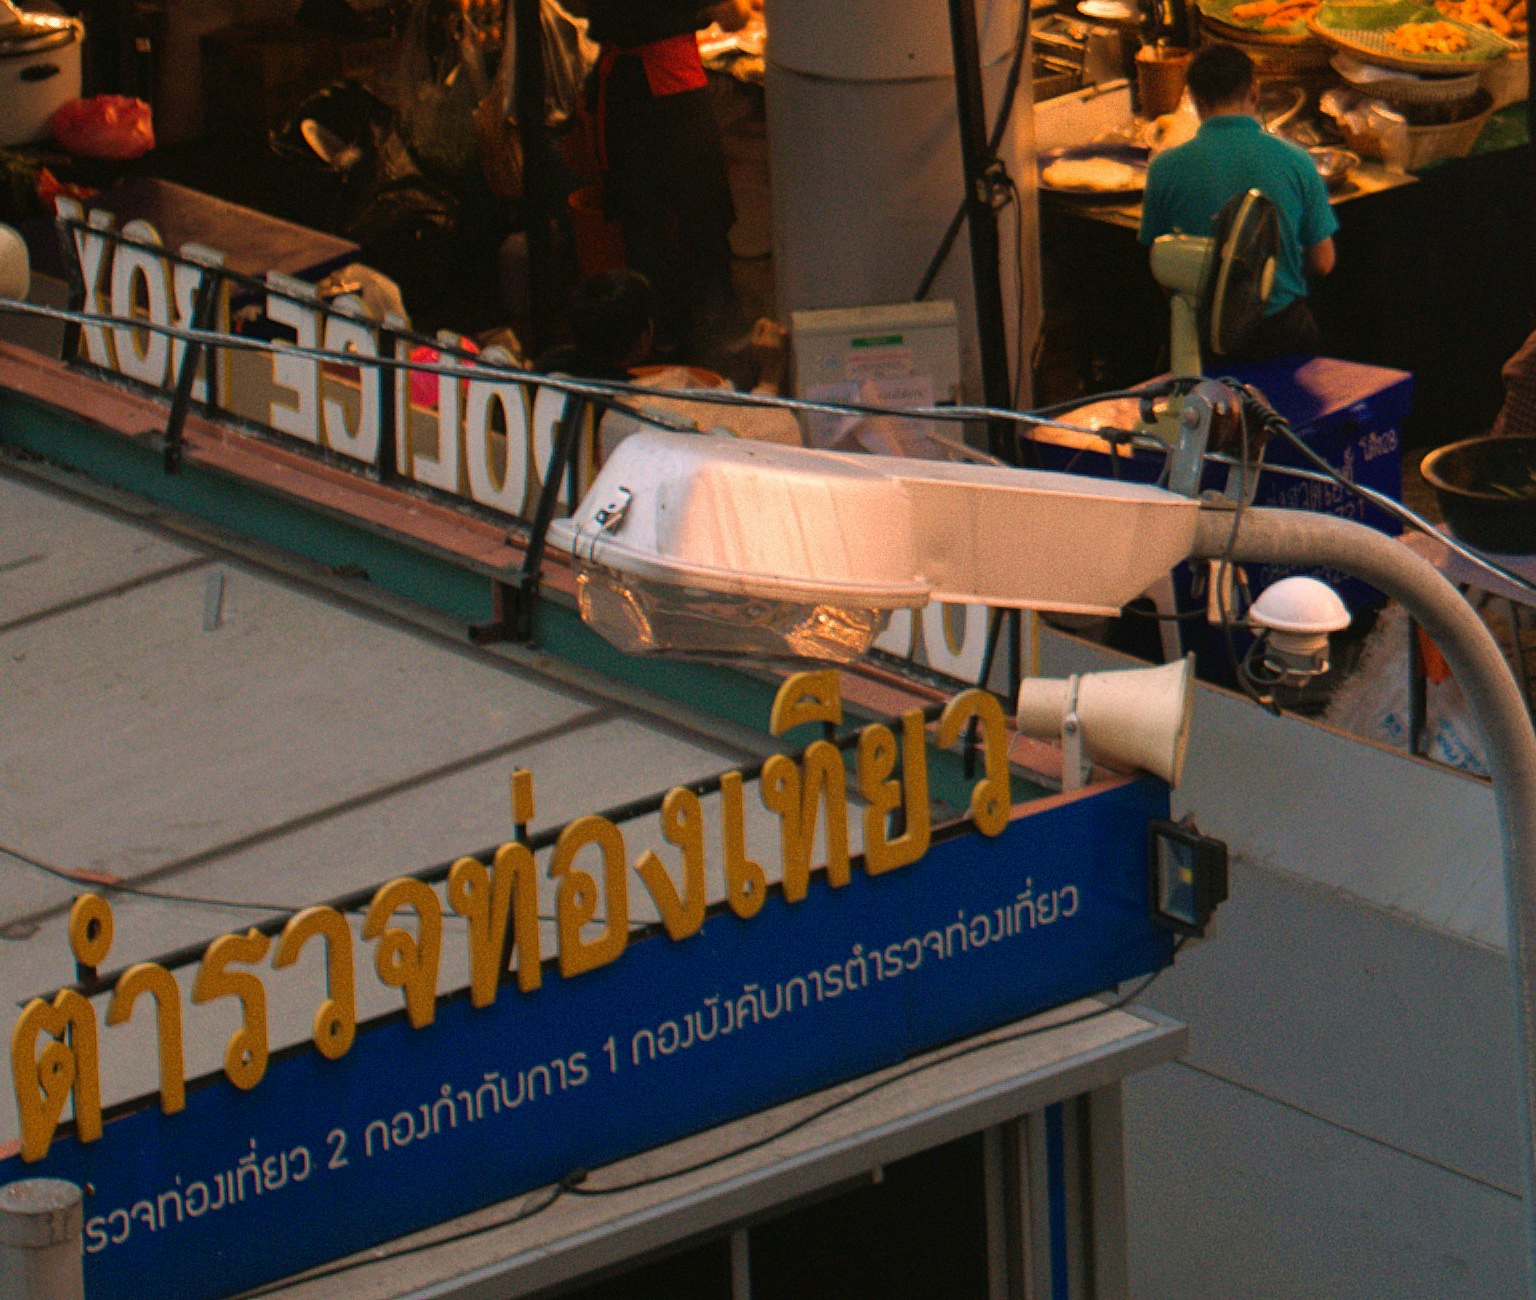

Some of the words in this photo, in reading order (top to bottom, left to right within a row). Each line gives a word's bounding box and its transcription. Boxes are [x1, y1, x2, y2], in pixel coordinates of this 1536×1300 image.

[327, 1130, 350, 1169] 2
[364, 1051, 590, 1161] กองกำกับการ
[603, 1037, 619, 1074] 1
